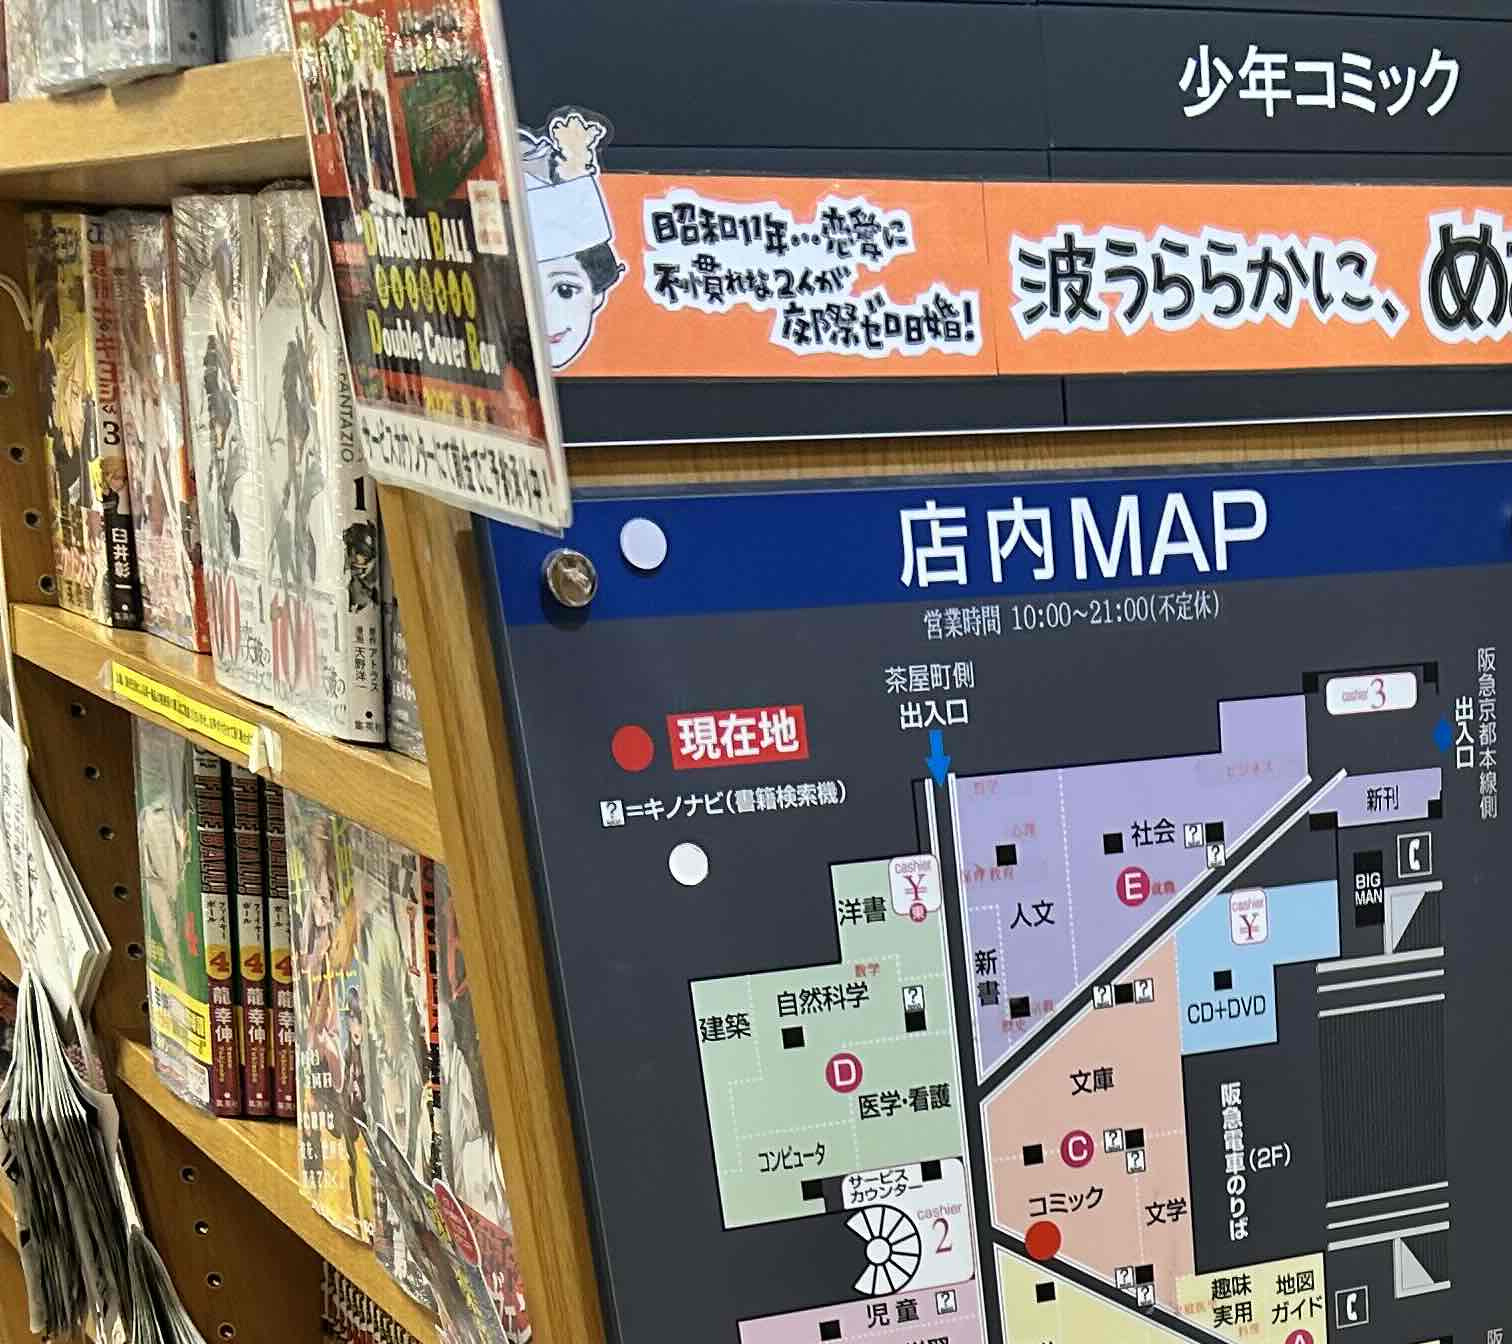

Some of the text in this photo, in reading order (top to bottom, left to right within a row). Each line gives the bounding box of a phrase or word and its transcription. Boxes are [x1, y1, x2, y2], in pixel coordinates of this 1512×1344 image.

[1178, 45, 1460, 117] 少年コミック
[361, 209, 473, 264] DRAGON BALL
[1018, 232, 1402, 325] 波うららかに、
[367, 308, 501, 376] Double Cover Box
[899, 489, 1268, 588] 店内MAP
[923, 608, 1002, 641] 営業時間
[884, 661, 976, 695] 茶屋町側
[1369, 678, 1387, 710] 3
[899, 699, 969, 729] 出入口
[678, 708, 801, 762] 現在地
[1455, 695, 1475, 769] 出入口
[1476, 646, 1498, 820] 阪急京都本線側
[1365, 783, 1400, 812] 新刊
[1130, 819, 1176, 848] 社会
[1354, 870, 1381, 891] BIG
[1354, 887, 1383, 906] MAN
[838, 896, 888, 926] 洋書
[1010, 900, 1056, 929] 人文
[974, 949, 1001, 1008] 新書
[777, 982, 870, 1018] 自然科学
[1187, 993, 1267, 1026] CD+DVD
[699, 1013, 753, 1043] 建築
[1069, 1067, 1115, 1097] 文庫
[858, 1083, 952, 1121] 医学・看護
[757, 1142, 827, 1174] コンピュータ
[1220, 1080, 1293, 1242] 阪急電車のりば (2F)
[847, 1169, 910, 1190] サービス
[849, 1179, 924, 1205] カウンター
[1028, 1186, 1105, 1218] コミック
[1144, 1197, 1189, 1229] 文学
[932, 1219, 953, 1256] 2
[1210, 1271, 1317, 1302] 趣味 地図
[866, 1299, 920, 1329] 児童
[1212, 1300, 1255, 1329] 実用
[1270, 1294, 1324, 1326] ガイド
